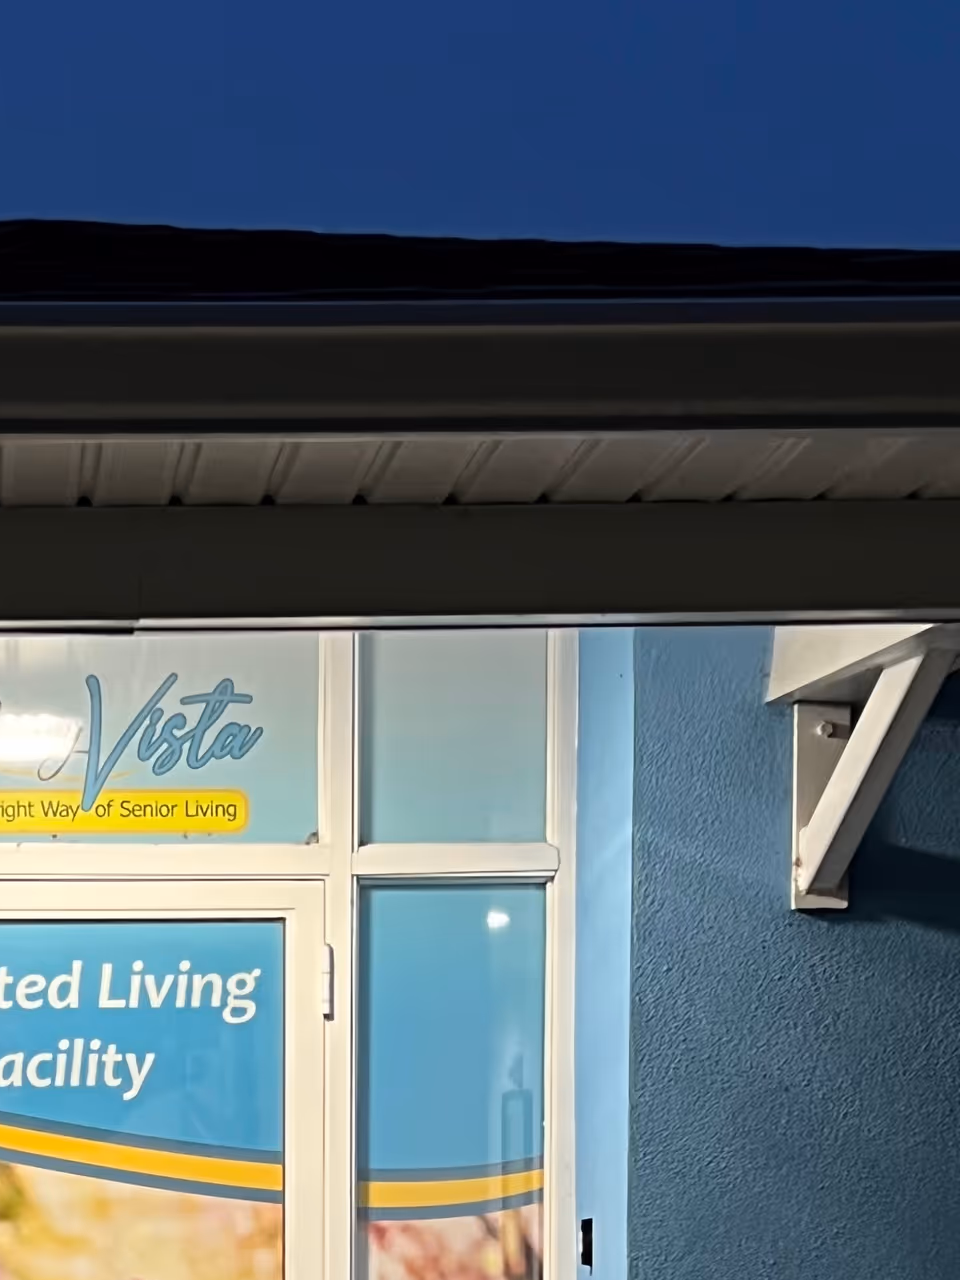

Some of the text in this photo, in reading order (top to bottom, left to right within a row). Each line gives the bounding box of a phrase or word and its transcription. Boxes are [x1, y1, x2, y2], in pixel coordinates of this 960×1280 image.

[81, 672, 263, 812] Vista
[40, 800, 80, 822] Way
[95, 799, 114, 818] of
[120, 799, 178, 818] Senior
[185, 800, 237, 821] Living
[97, 959, 262, 1024] Living
